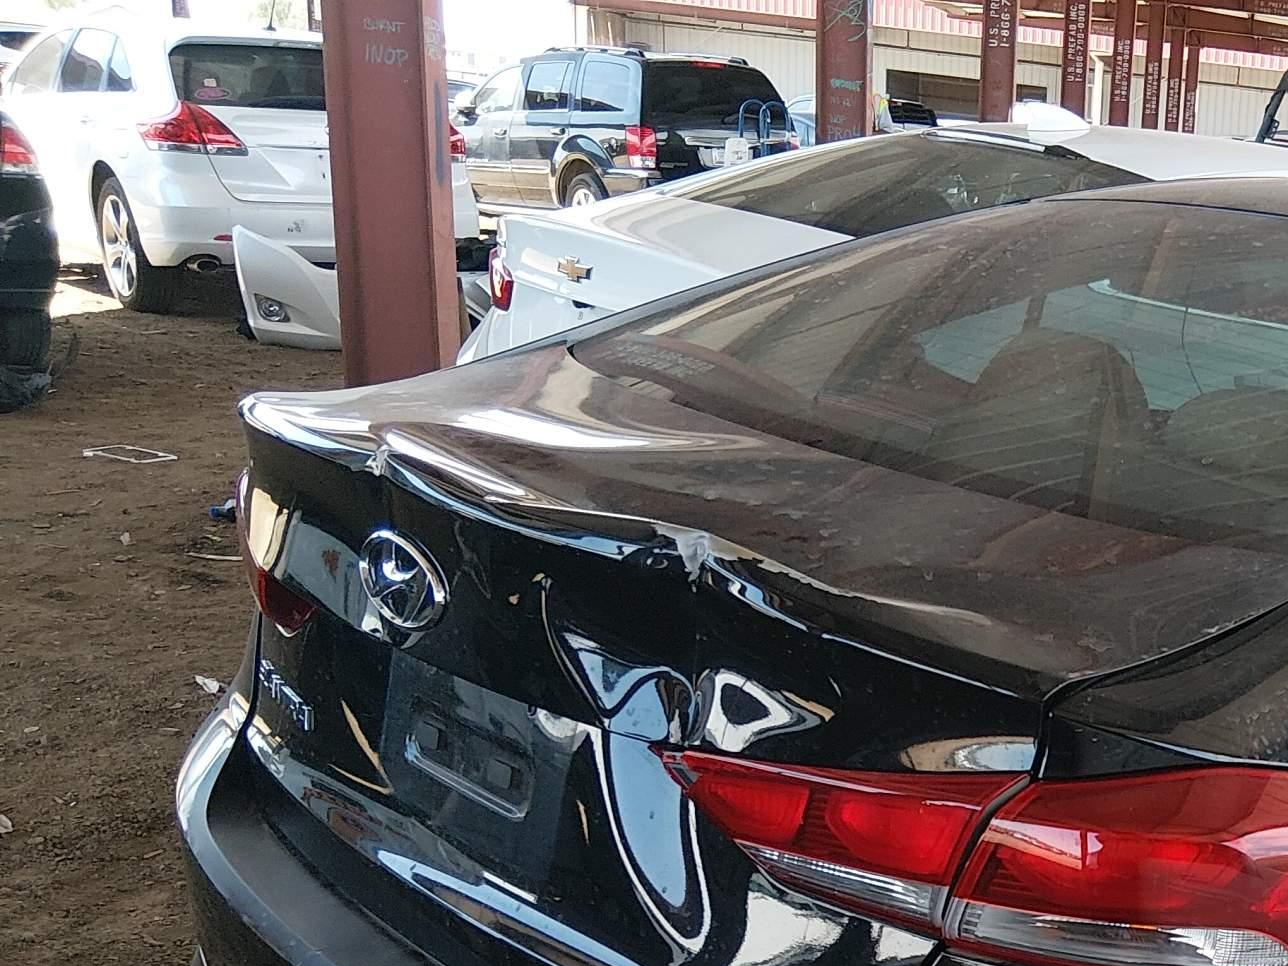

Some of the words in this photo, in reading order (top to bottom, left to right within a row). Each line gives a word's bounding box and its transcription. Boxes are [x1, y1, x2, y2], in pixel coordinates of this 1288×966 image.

[990, 0, 1000, 17] PR
[1070, 2, 1079, 20] INC.
[988, 24, 999, 47] U.S.
[366, 42, 408, 66] INOP
[1067, 64, 1075, 82] U.S.
